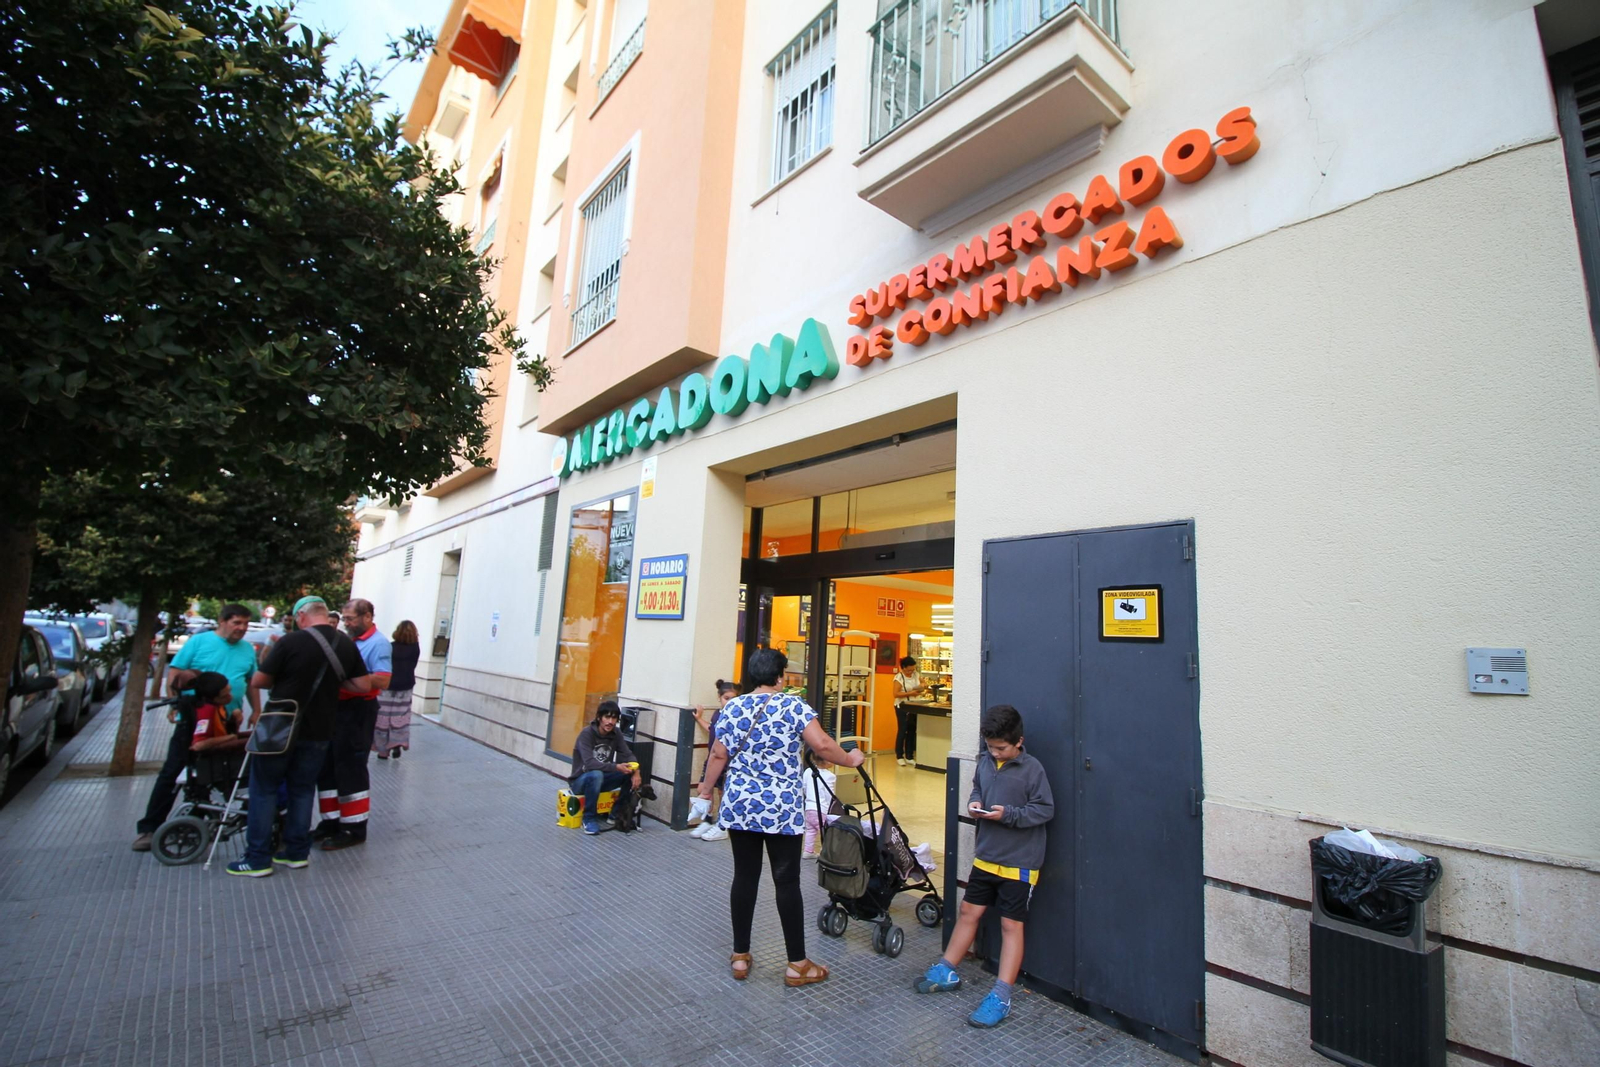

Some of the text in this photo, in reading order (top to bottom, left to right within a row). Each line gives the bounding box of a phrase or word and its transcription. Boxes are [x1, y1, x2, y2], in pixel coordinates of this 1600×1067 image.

[845, 205, 1184, 368] DE CONFIANZA
[848, 106, 1260, 329] SUPERMERCADOS
[569, 317, 839, 473] MERCADONA
[650, 559, 684, 575] HORARIO
